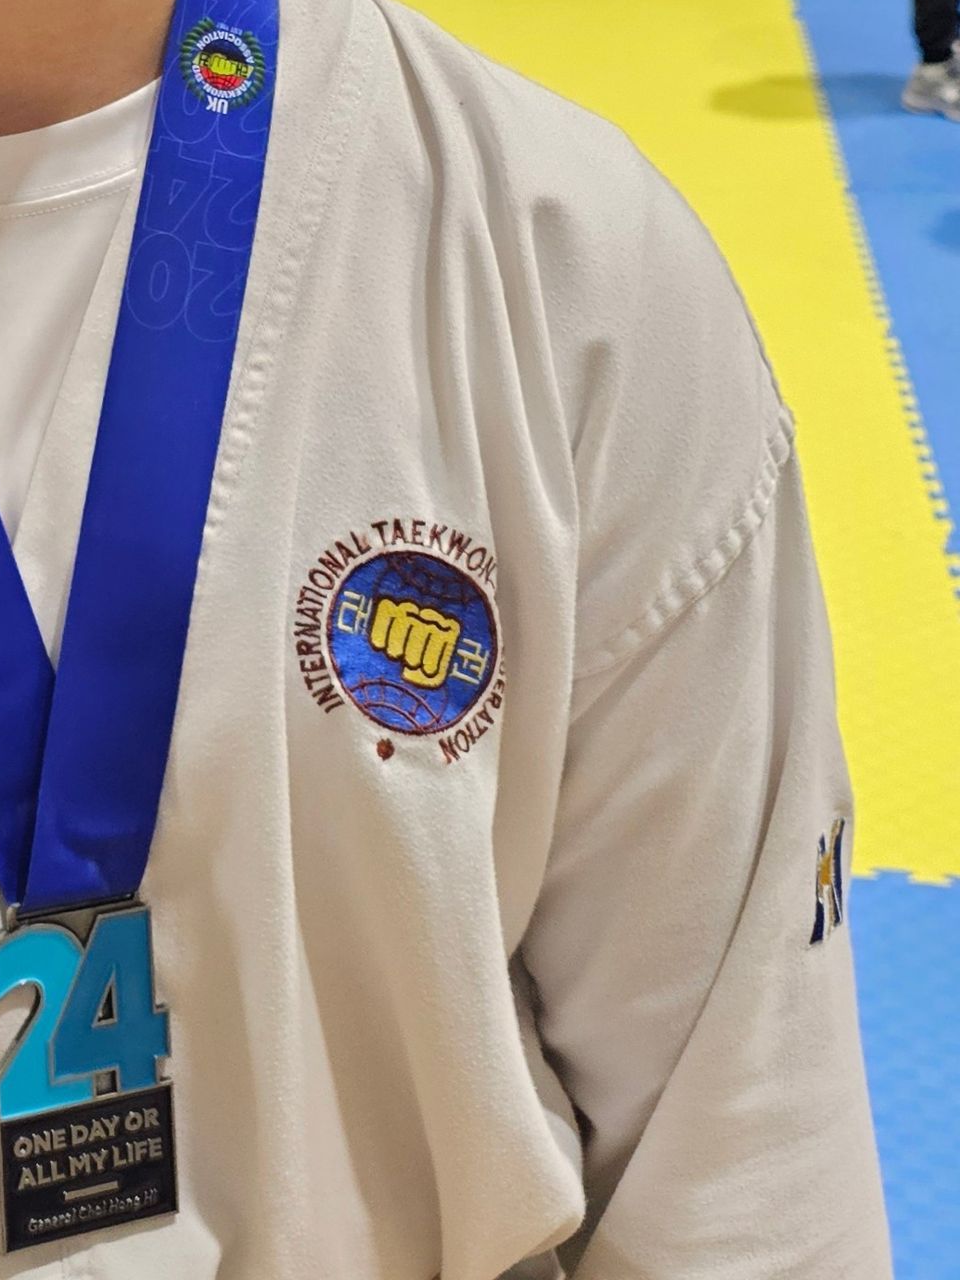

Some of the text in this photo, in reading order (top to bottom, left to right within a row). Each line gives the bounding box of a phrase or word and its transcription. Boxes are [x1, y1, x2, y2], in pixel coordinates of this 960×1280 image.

[196, 30, 255, 64] ASSOCIATION
[192, 65, 252, 99] TAEKWON-DO
[205, 95, 229, 115] UK
[294, 531, 372, 714] INTERNATIONAL
[439, 660, 507, 764] ERATION
[13, 1107, 160, 1158] ONE DAY OR
[17, 1137, 163, 1191] ALL MY LIFE
[29, 1207, 77, 1232] General
[78, 1199, 107, 1220] Choi
[109, 1191, 142, 1216] Hong
